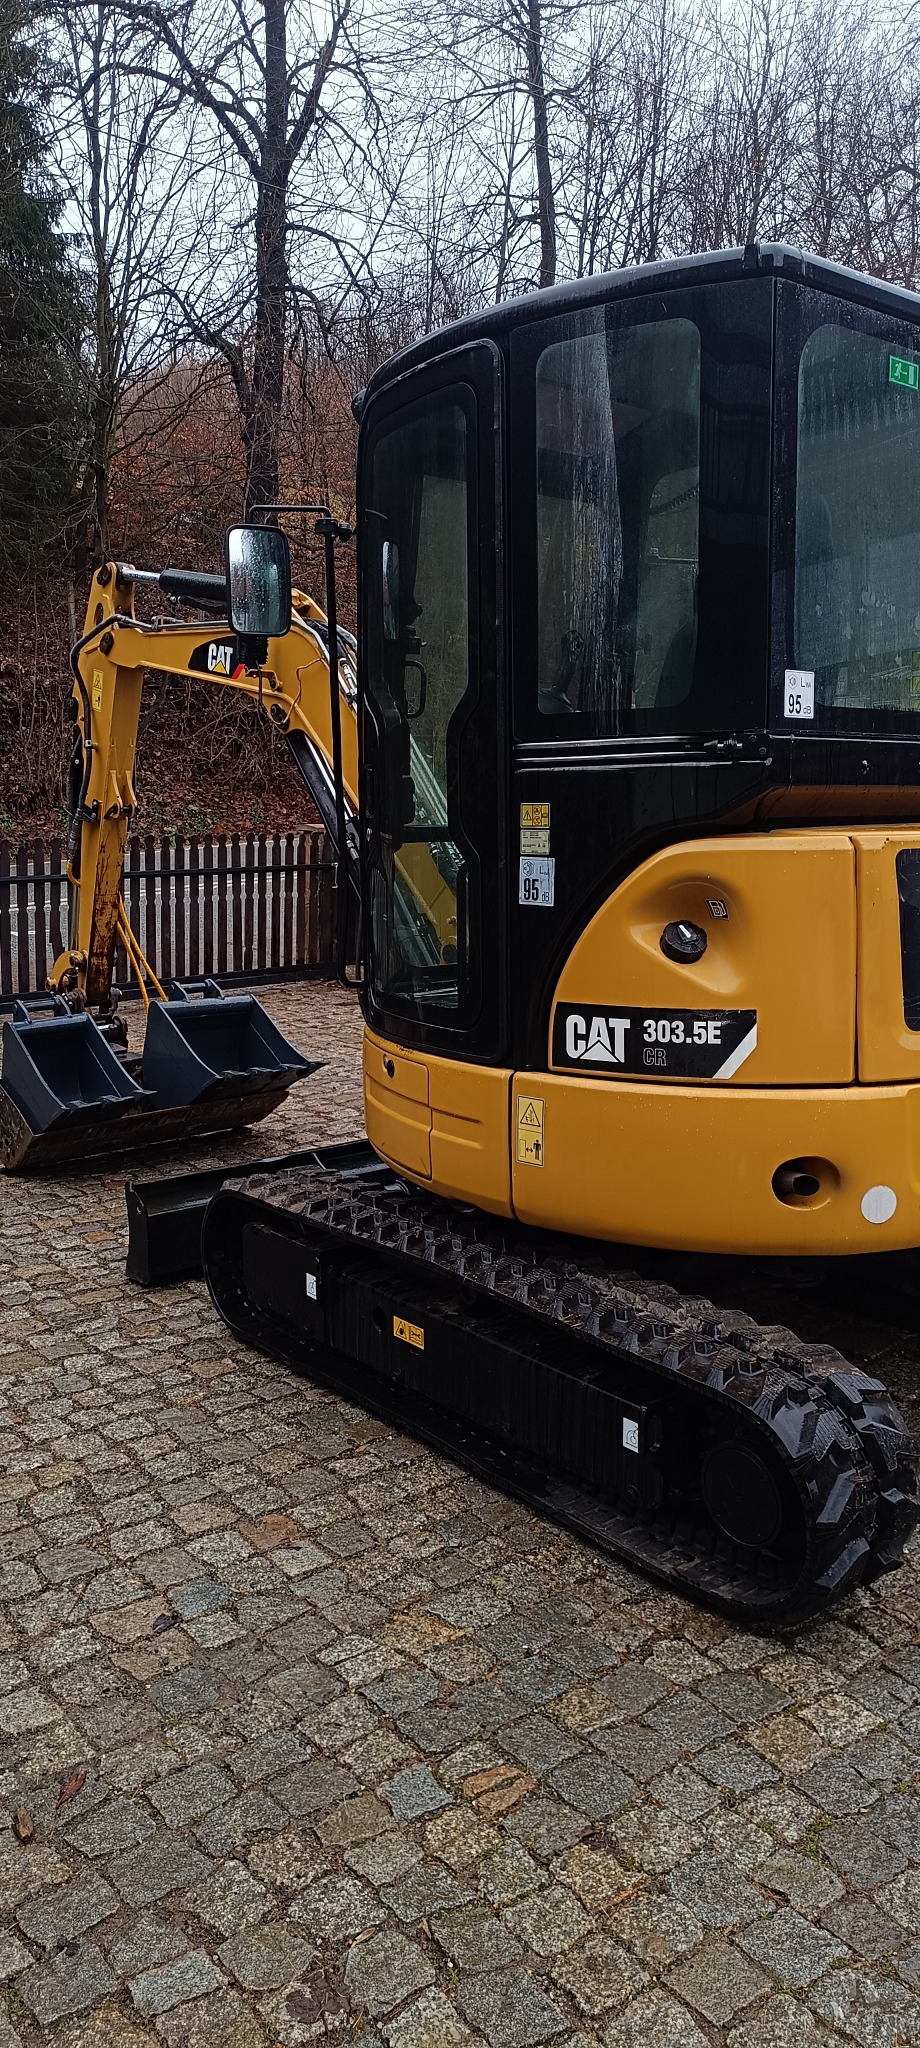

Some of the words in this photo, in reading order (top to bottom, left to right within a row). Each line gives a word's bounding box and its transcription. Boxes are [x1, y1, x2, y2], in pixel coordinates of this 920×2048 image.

[207, 643, 234, 675] CAT
[788, 693, 802, 714] 95
[523, 877, 540, 901] 95
[565, 1014, 631, 1063] CAT
[643, 1019, 722, 1045] 303.5E
[643, 1047, 667, 1067] CR
